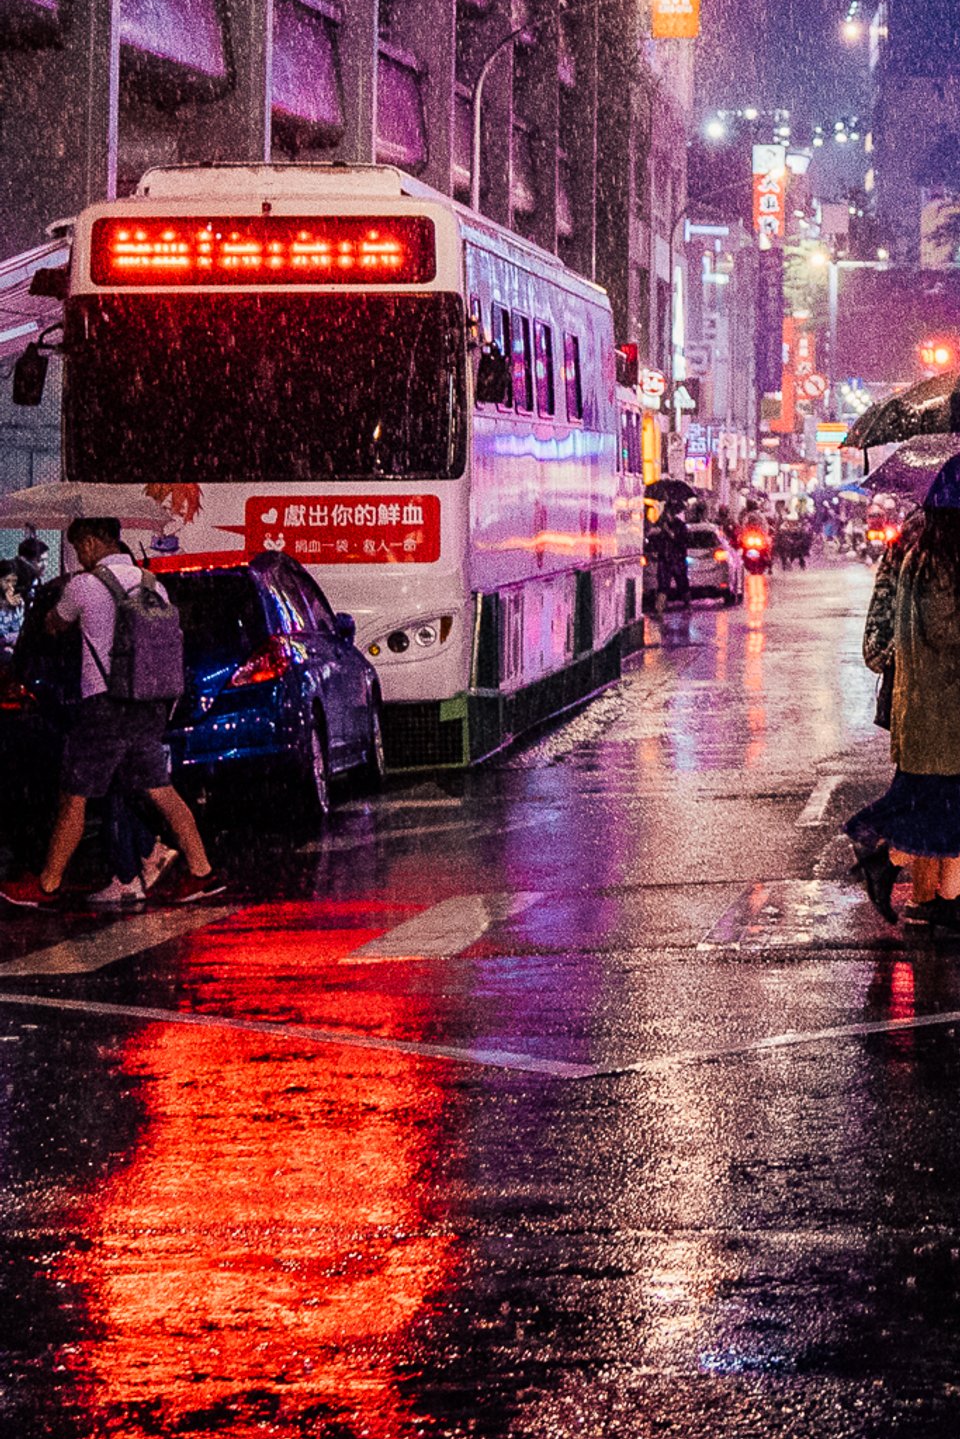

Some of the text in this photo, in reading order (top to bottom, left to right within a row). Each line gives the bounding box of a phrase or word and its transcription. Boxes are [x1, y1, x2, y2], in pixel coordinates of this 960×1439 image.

[283, 503, 425, 527] 獻出你的鮮血
